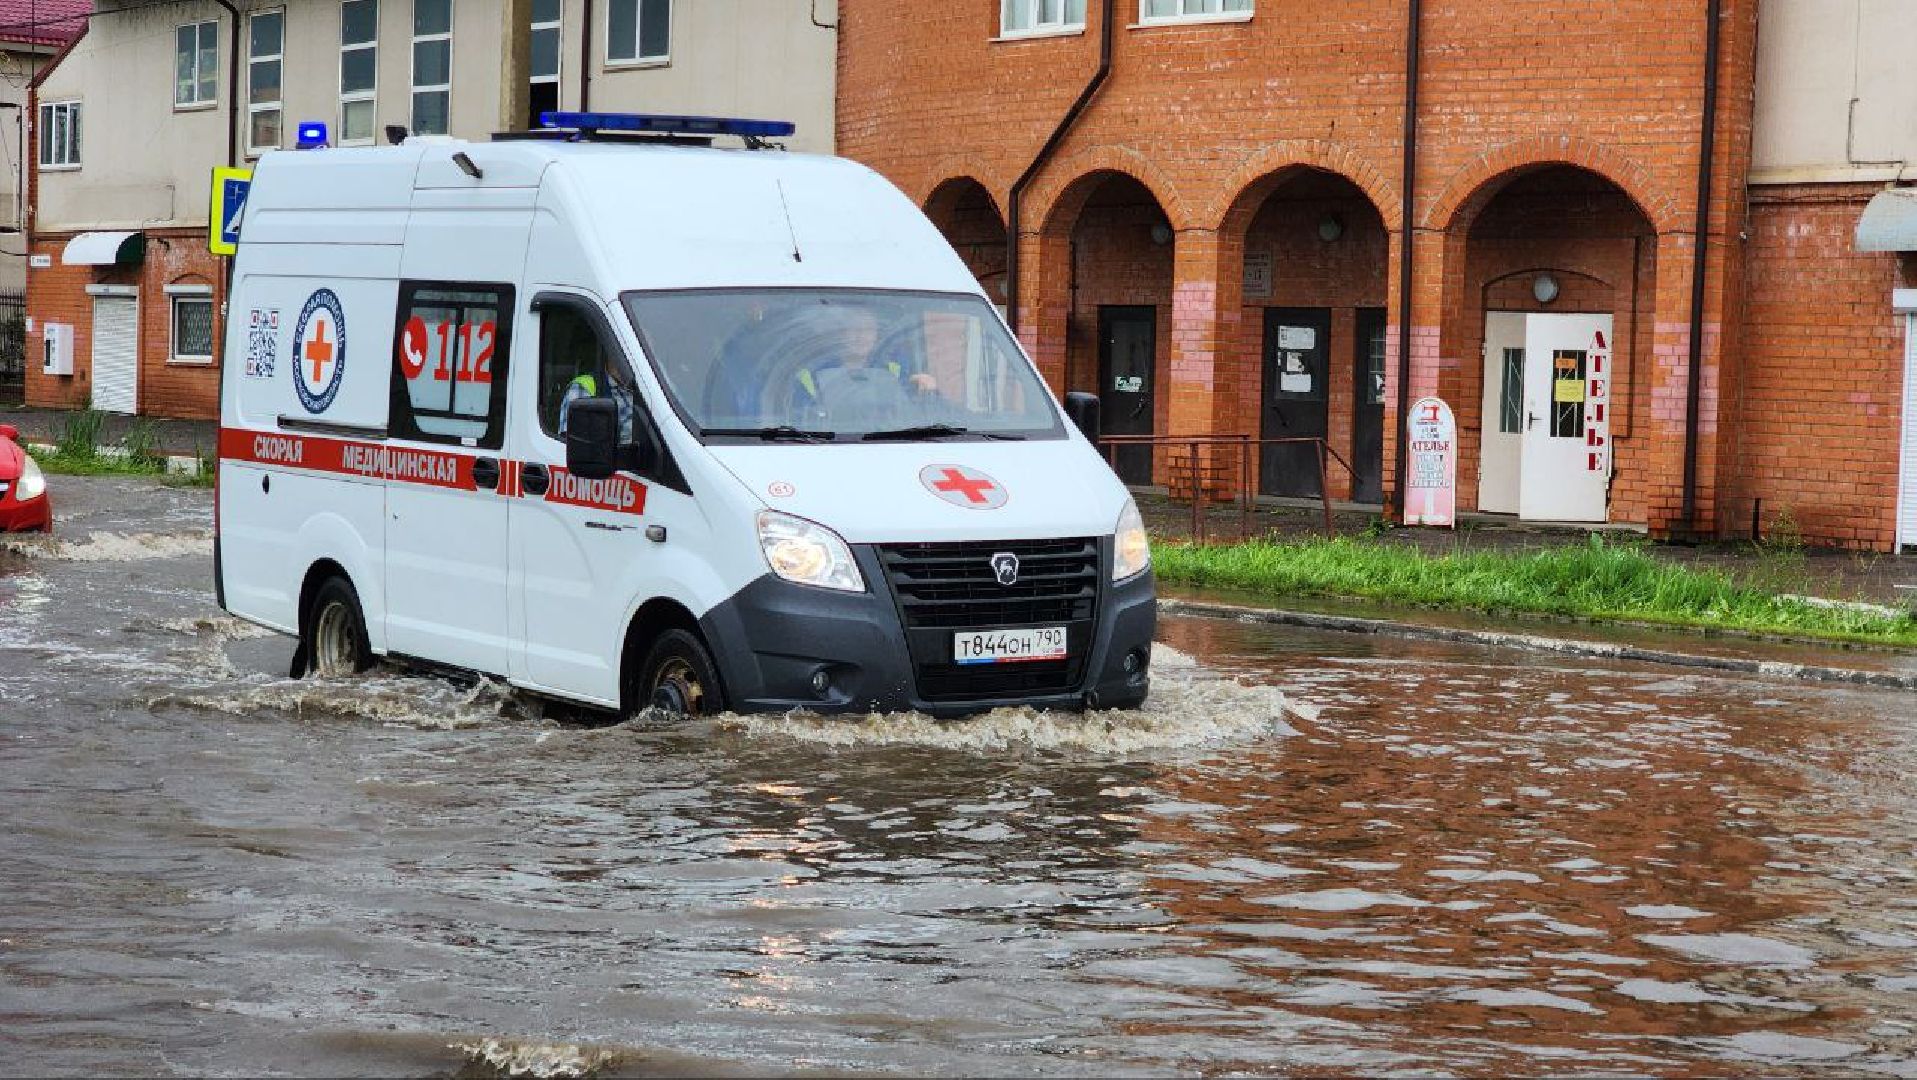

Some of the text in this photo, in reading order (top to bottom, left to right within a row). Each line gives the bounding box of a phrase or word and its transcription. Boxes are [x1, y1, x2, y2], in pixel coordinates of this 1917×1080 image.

[434, 320, 498, 383] 112
[1587, 331, 1607, 471] АТЕЛЬЕ
[254, 434, 636, 510] СКОРАЯ МЕДИЦИНСКАЯ ПОМОЩЬ
[1411, 441, 1450, 451] АТЕЛЬЕ
[961, 634, 1031, 656] Т844ОН
